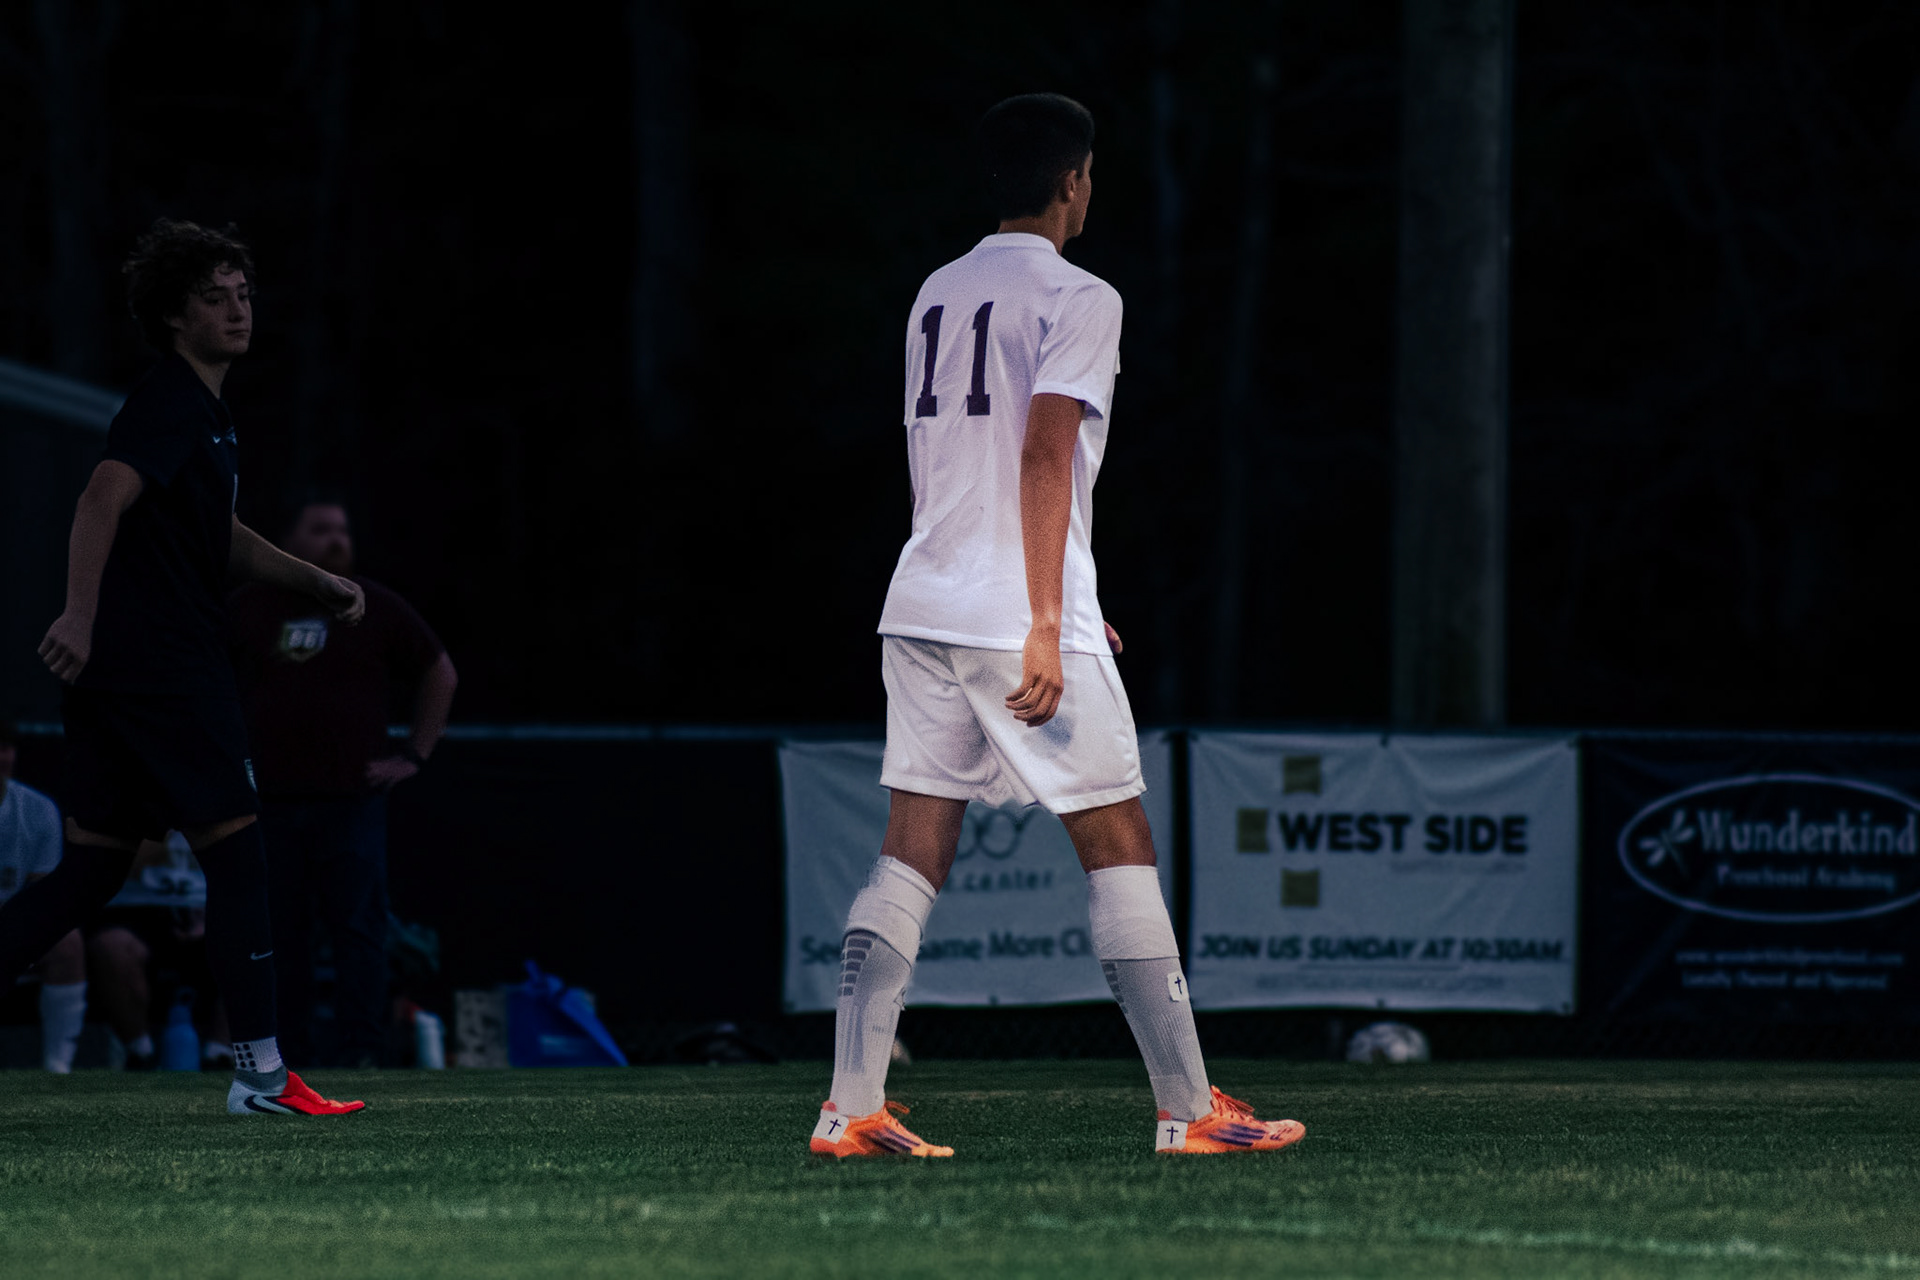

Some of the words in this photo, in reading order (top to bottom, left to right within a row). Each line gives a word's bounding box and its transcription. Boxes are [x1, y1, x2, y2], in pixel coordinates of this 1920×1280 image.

[916, 301, 994, 419] 11
[1278, 813, 1411, 852] WEST
[1425, 814, 1529, 854] SIDE
[1696, 807, 1919, 855] Wunderkind
[988, 931, 1055, 960] More
[1196, 935, 1261, 960] JOIN
[1267, 936, 1303, 961] US
[1308, 937, 1417, 961] SUNDAY
[1419, 937, 1457, 961] AT
